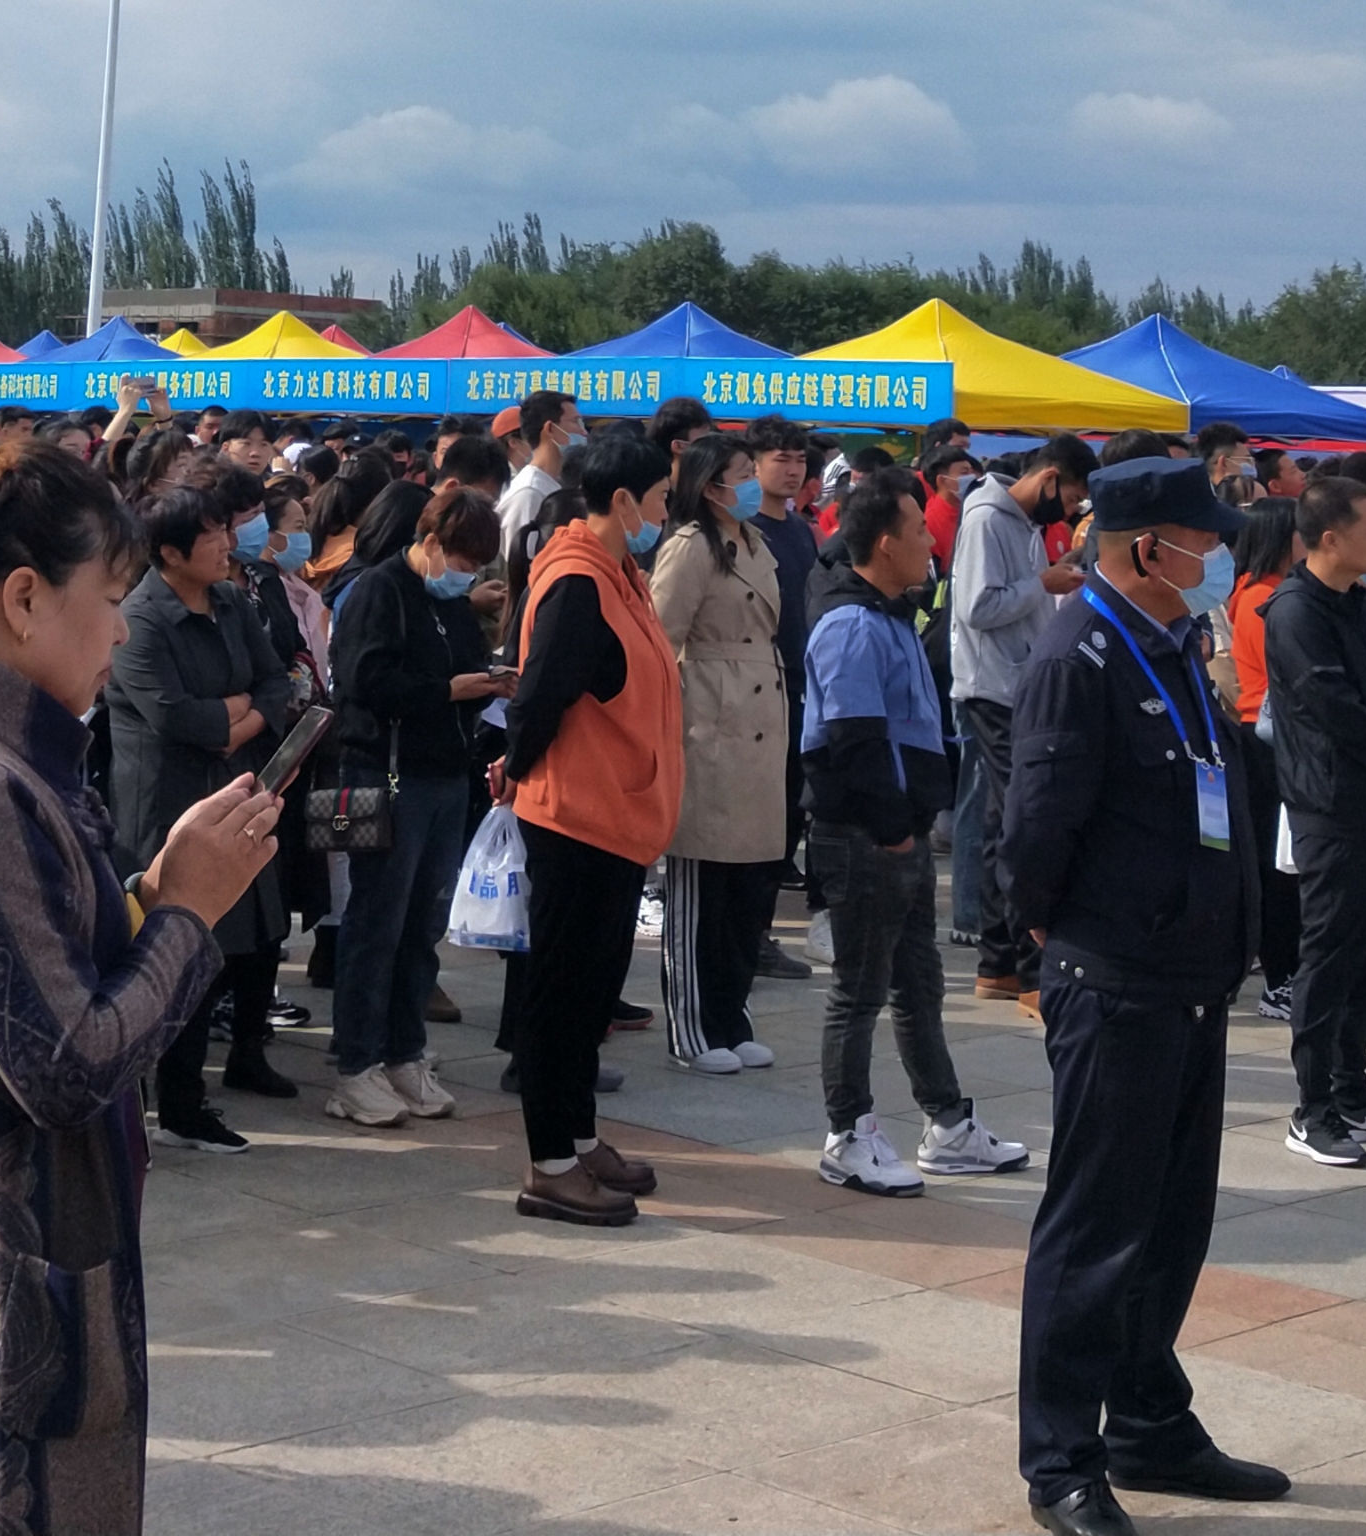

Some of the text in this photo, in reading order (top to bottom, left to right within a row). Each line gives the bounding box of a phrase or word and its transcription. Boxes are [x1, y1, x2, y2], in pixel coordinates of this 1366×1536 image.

[703, 370, 929, 410] 北京极兔供应链管理有限公司
